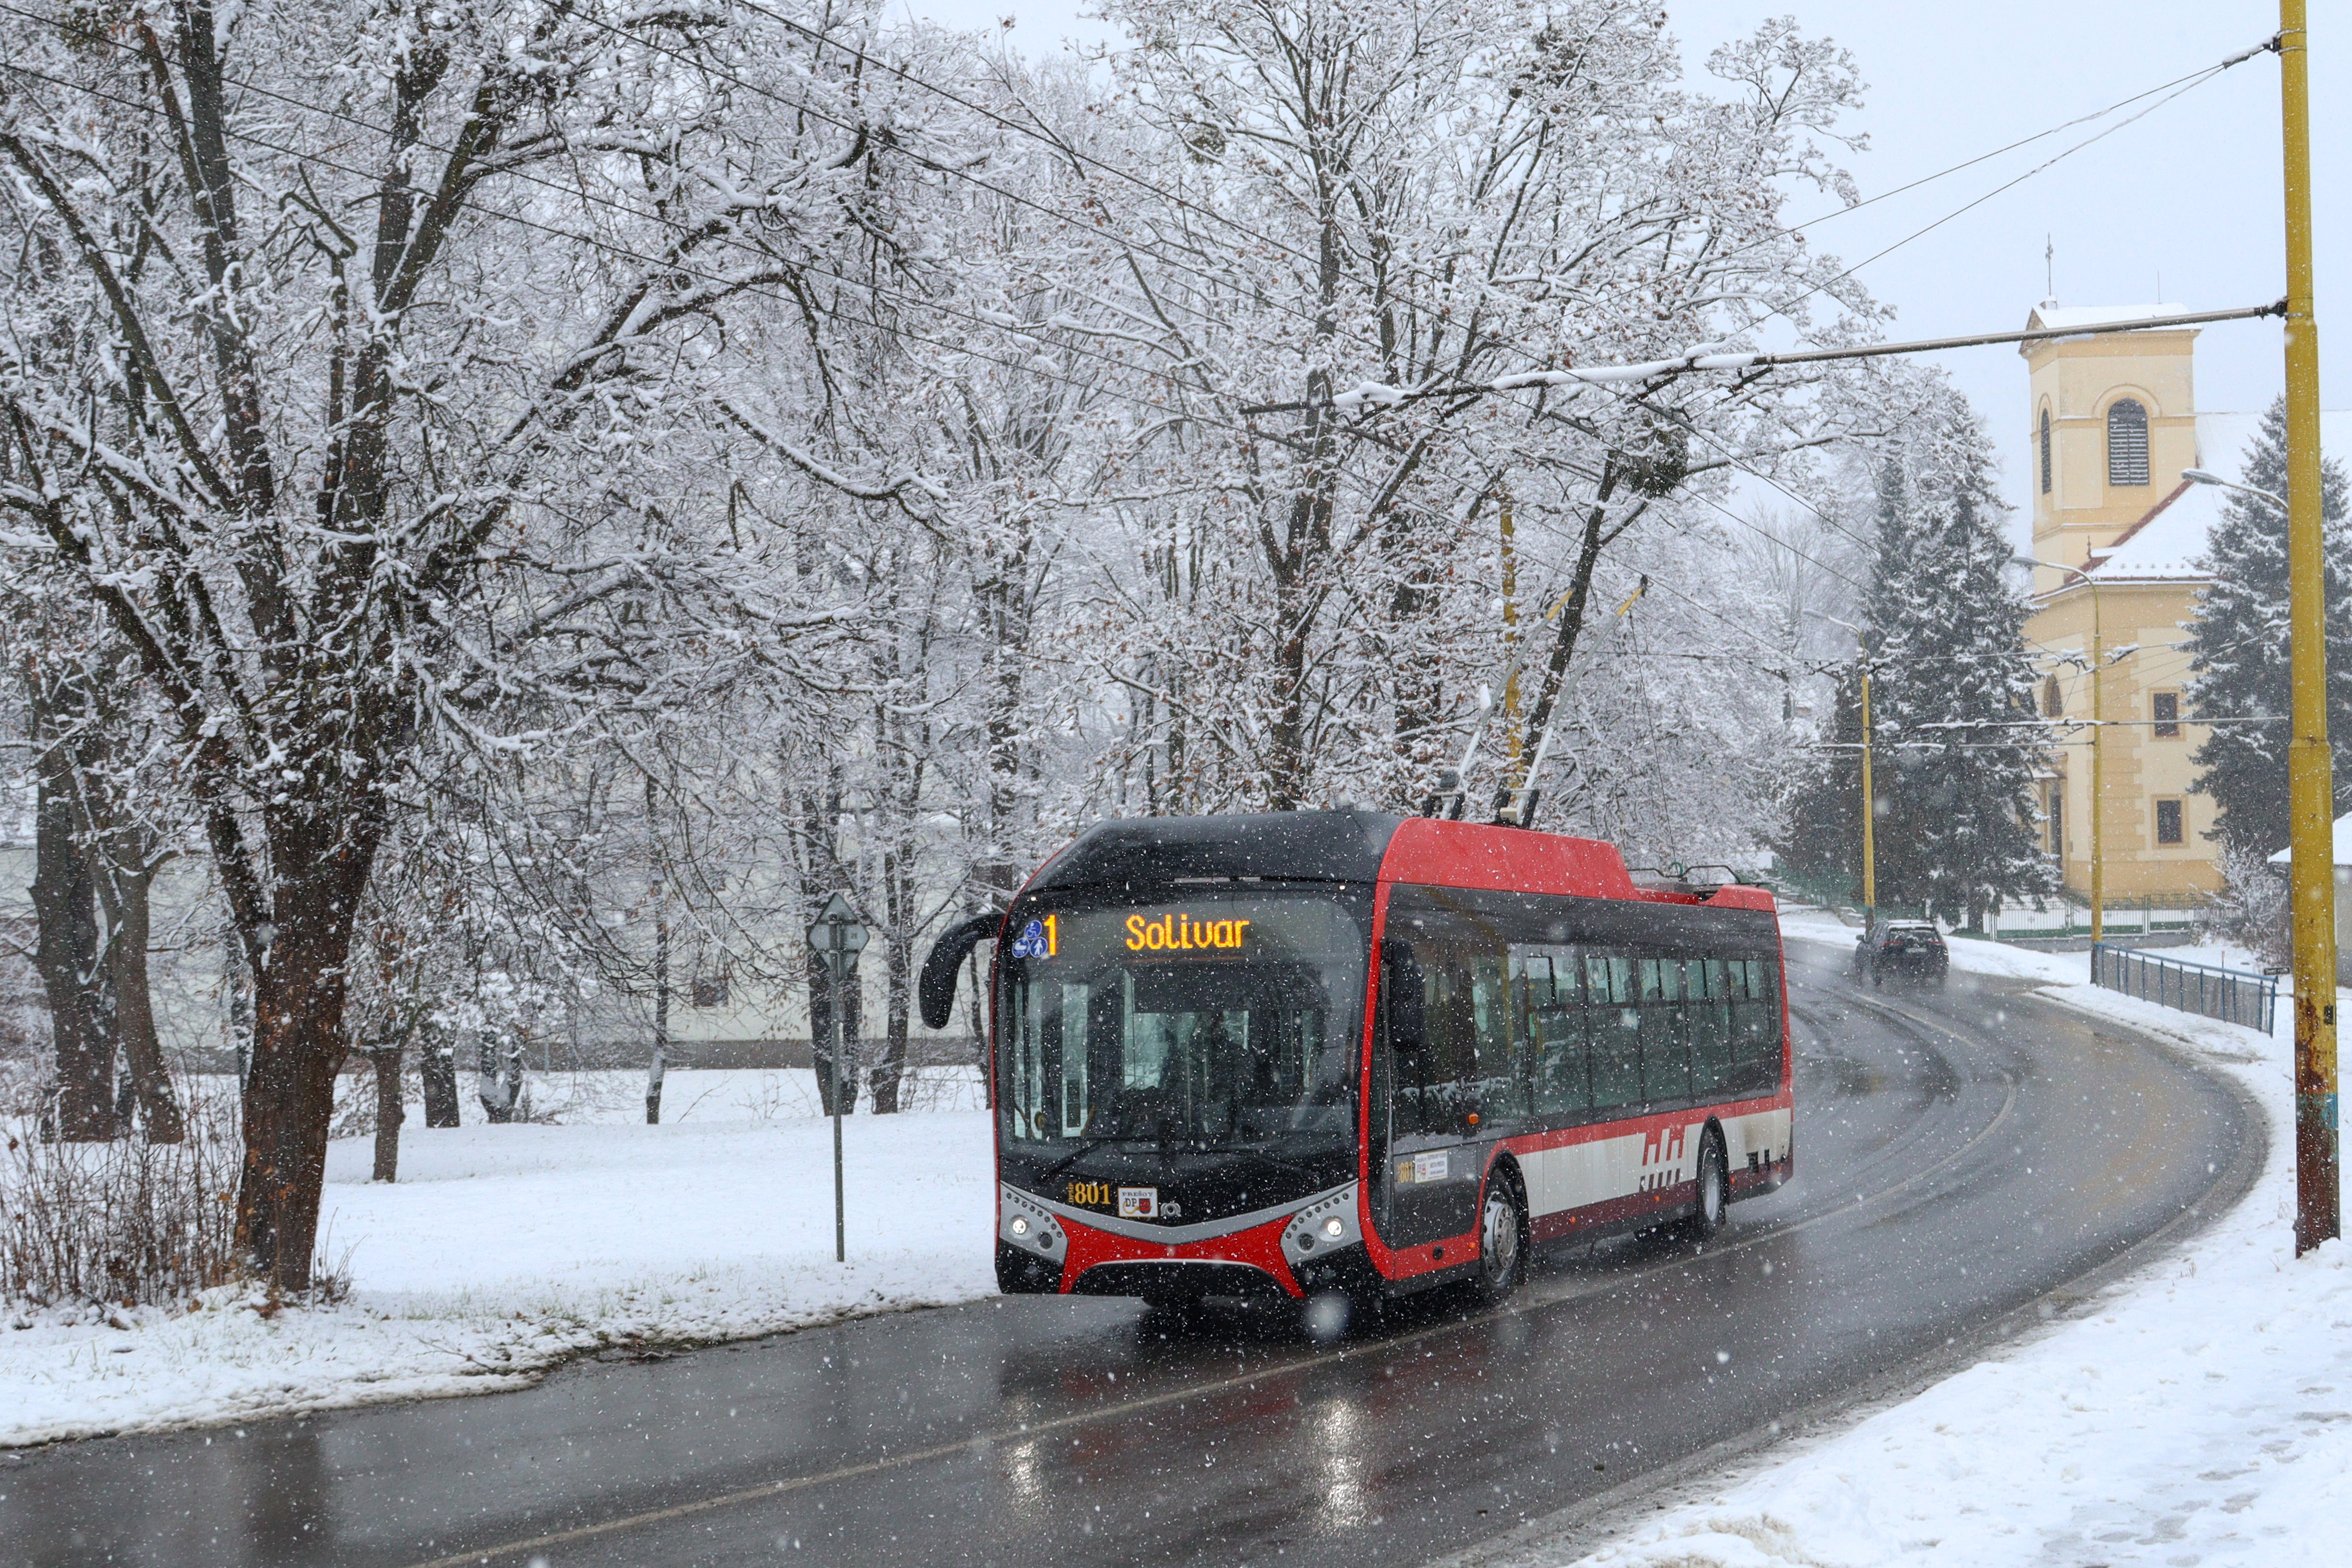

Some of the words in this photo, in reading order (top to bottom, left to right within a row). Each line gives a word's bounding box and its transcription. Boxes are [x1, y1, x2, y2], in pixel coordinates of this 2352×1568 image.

[1044, 914, 1057, 956] 1
[1125, 913, 1249, 950] Solivar
[1400, 1162, 1414, 1184] 801
[1074, 1183, 1111, 1205] 801
[1125, 1198, 1137, 1207] DP
